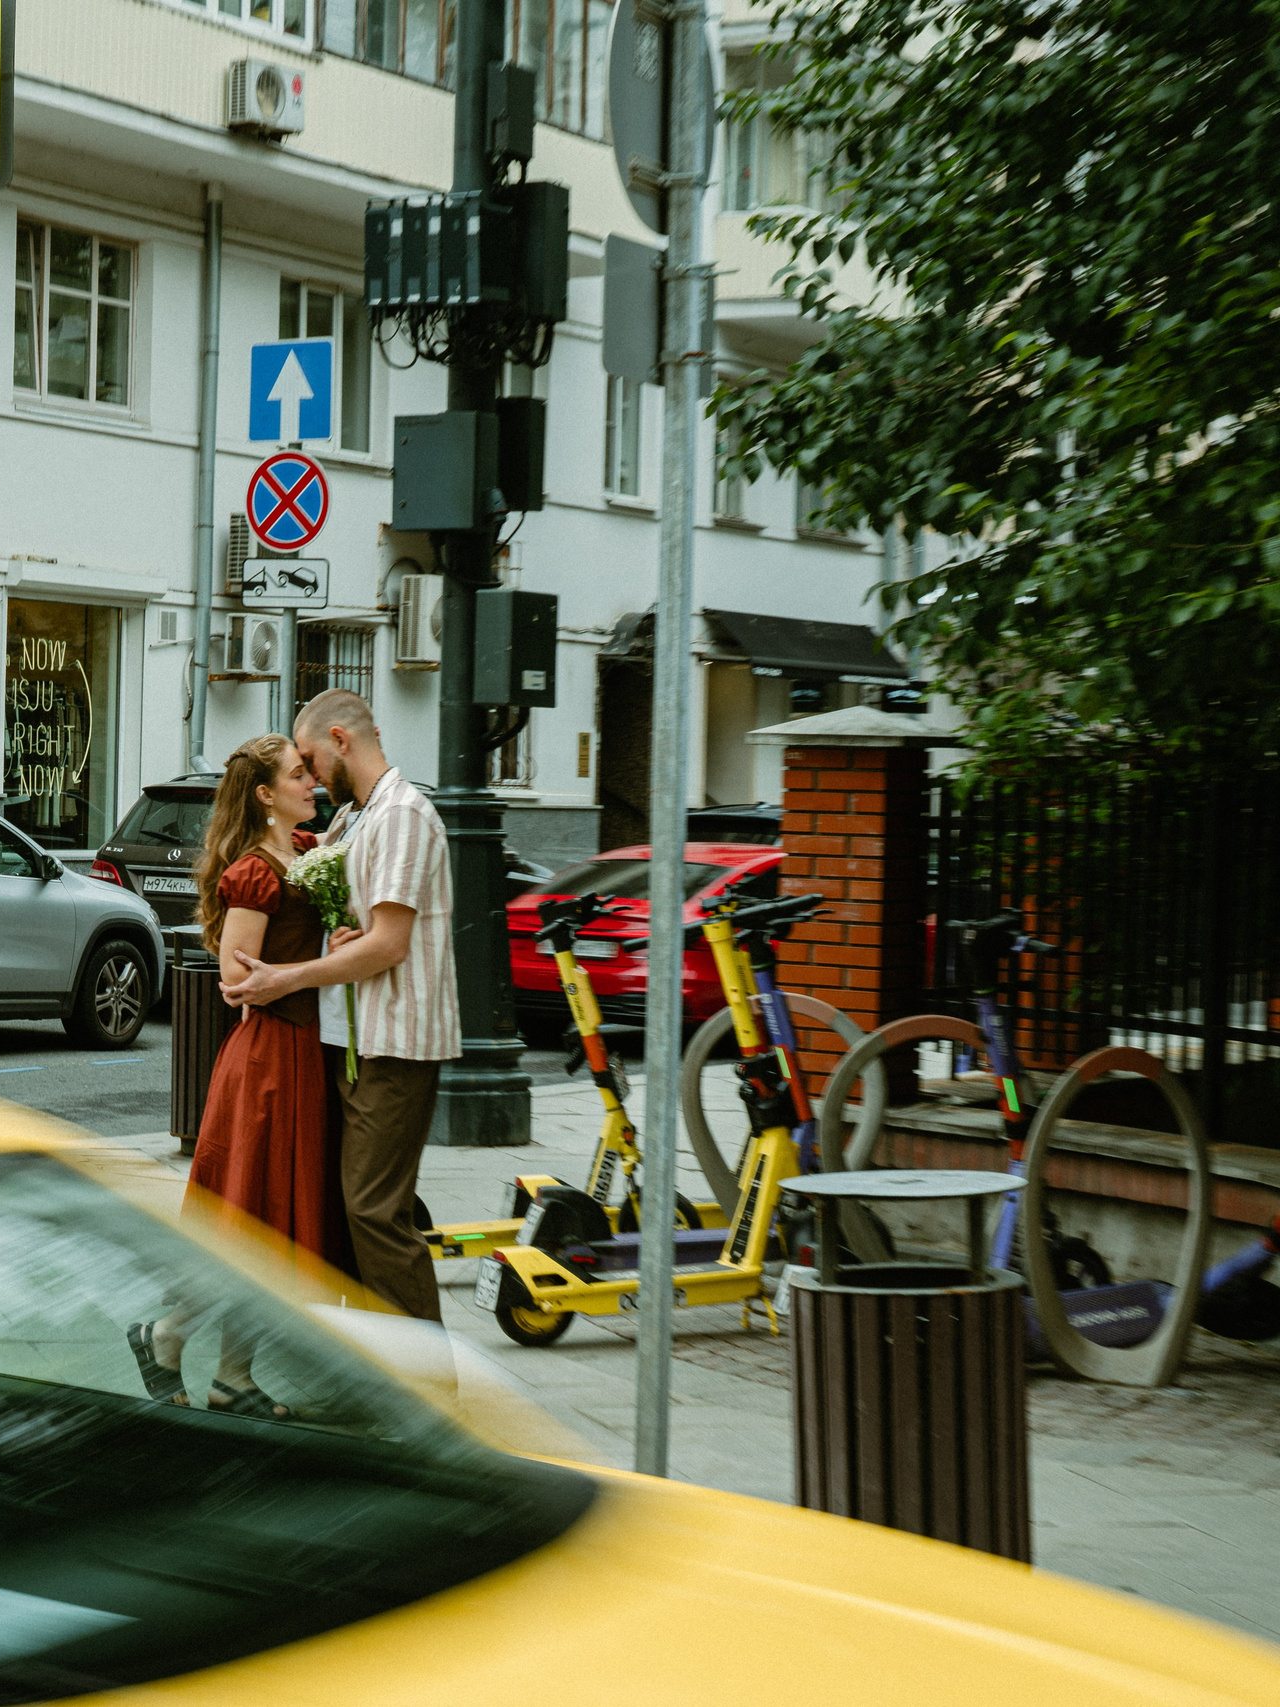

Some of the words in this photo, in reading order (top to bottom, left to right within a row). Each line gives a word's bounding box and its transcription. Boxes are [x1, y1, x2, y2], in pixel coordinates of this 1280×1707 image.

[21, 637, 67, 671] NOW
[12, 721, 76, 757] RIGHT
[18, 764, 65, 797] NOW
